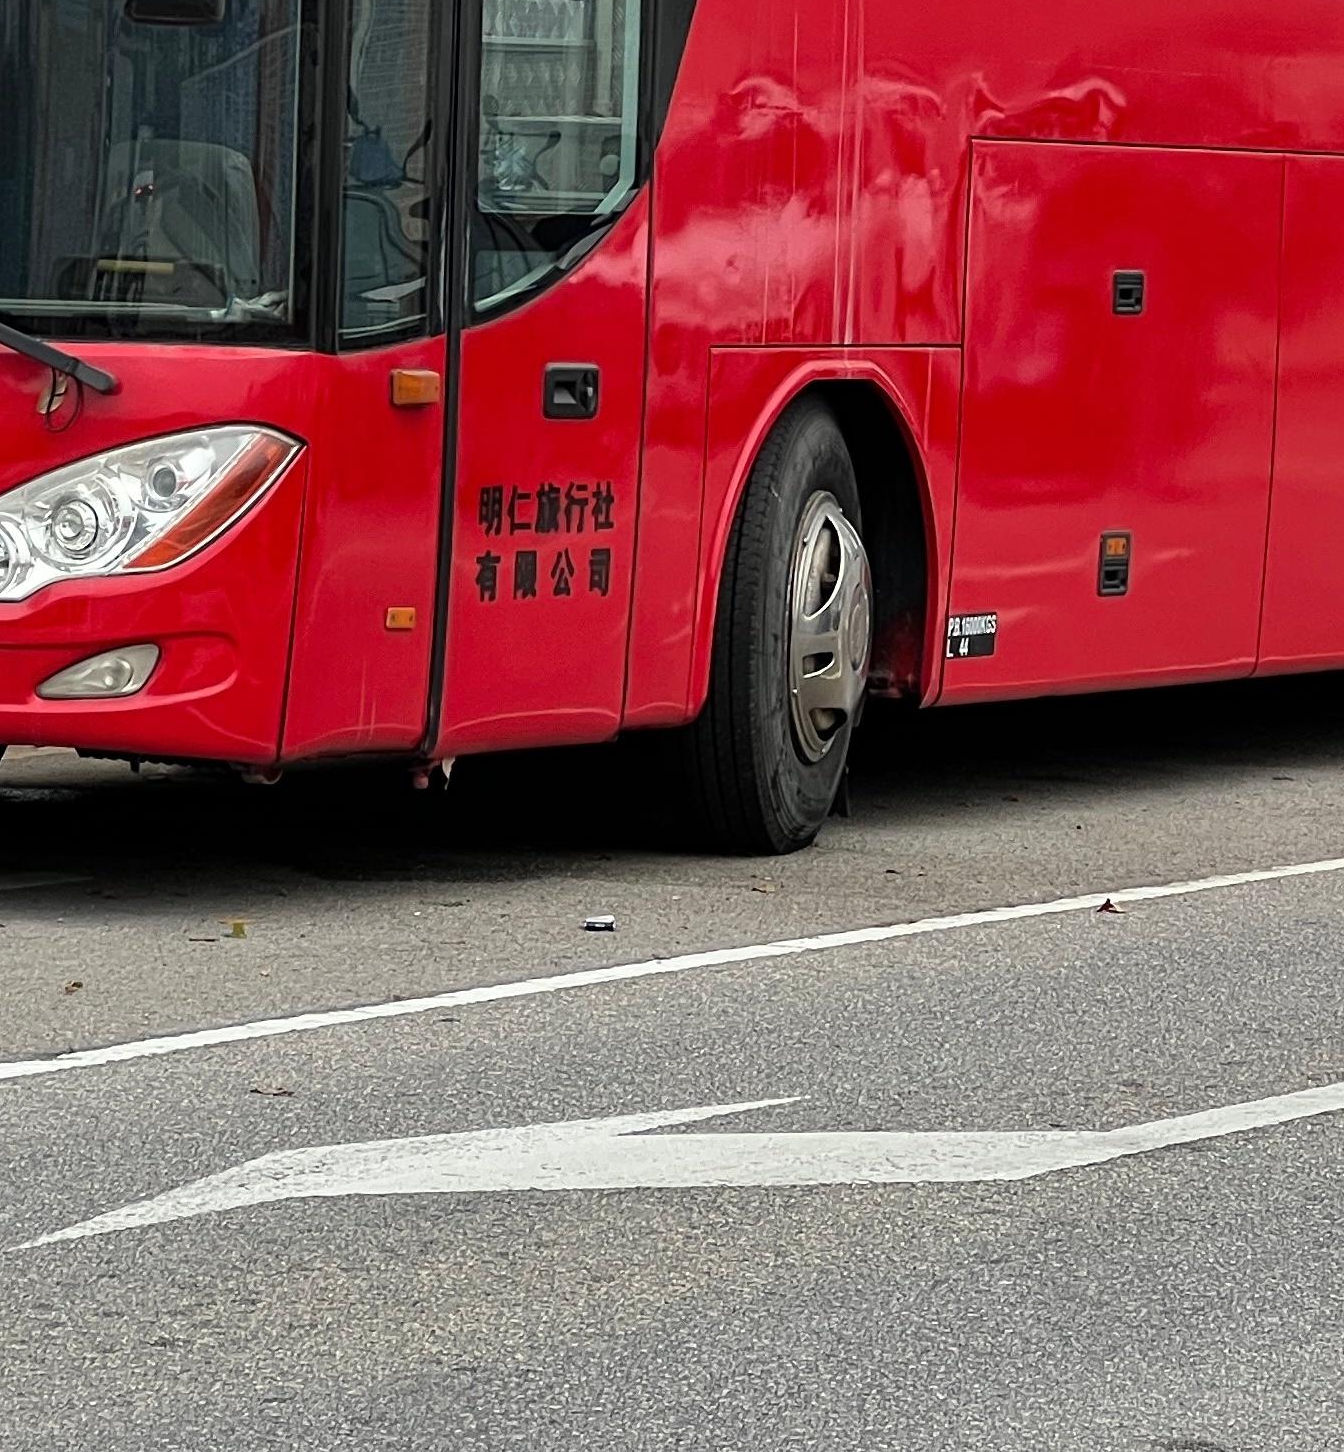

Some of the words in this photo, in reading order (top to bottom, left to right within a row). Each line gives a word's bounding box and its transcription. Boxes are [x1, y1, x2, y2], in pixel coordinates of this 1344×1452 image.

[479, 481, 615, 537] 明仁旅行社
[476, 548, 611, 602] 有限公司
